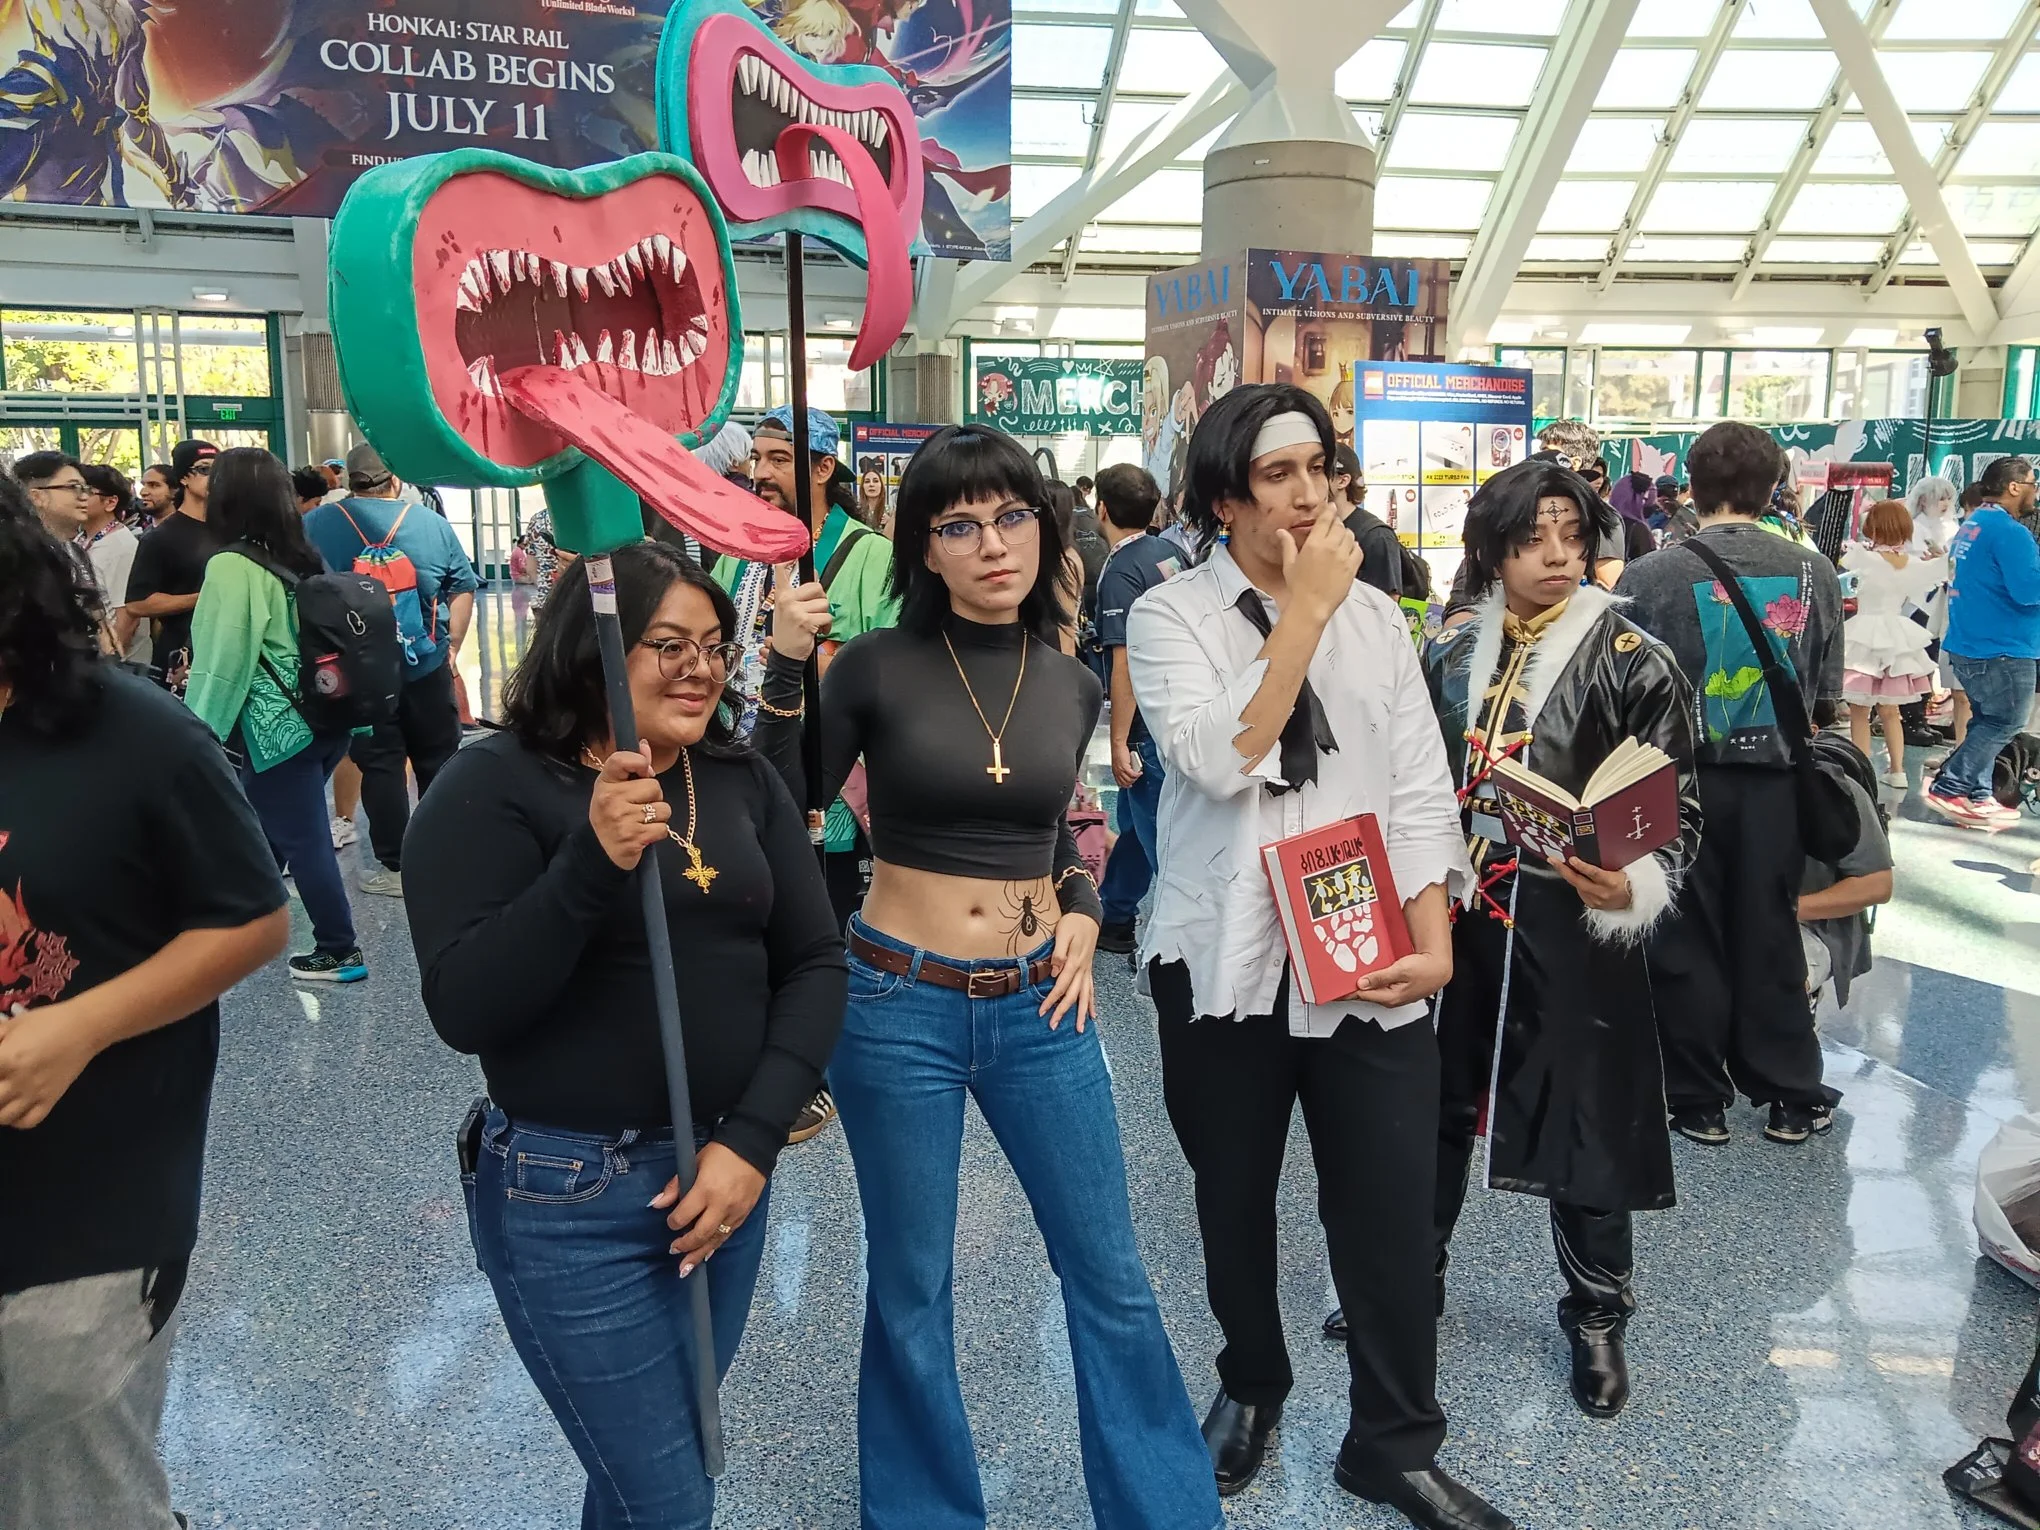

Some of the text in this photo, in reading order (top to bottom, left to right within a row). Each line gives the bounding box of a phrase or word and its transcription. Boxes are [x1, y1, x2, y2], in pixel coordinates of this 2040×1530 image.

[368, 12, 569, 50] HONKAI: STAR RAIL
[320, 39, 616, 94] COLLAB BEGINS
[384, 91, 550, 141] JULY 11
[351, 154, 385, 166] FIND
[1155, 265, 1230, 319] YABAI
[1269, 260, 1420, 307] YABAI
[1262, 308, 1435, 324] INTIMATE VISIONS AND SUBVERSIVE BEAUTY
[1386, 373, 1442, 389] OFFICIAL
[1445, 375, 1526, 394] MERCHANDISE
[869, 428, 900, 437] OFFICIAL
